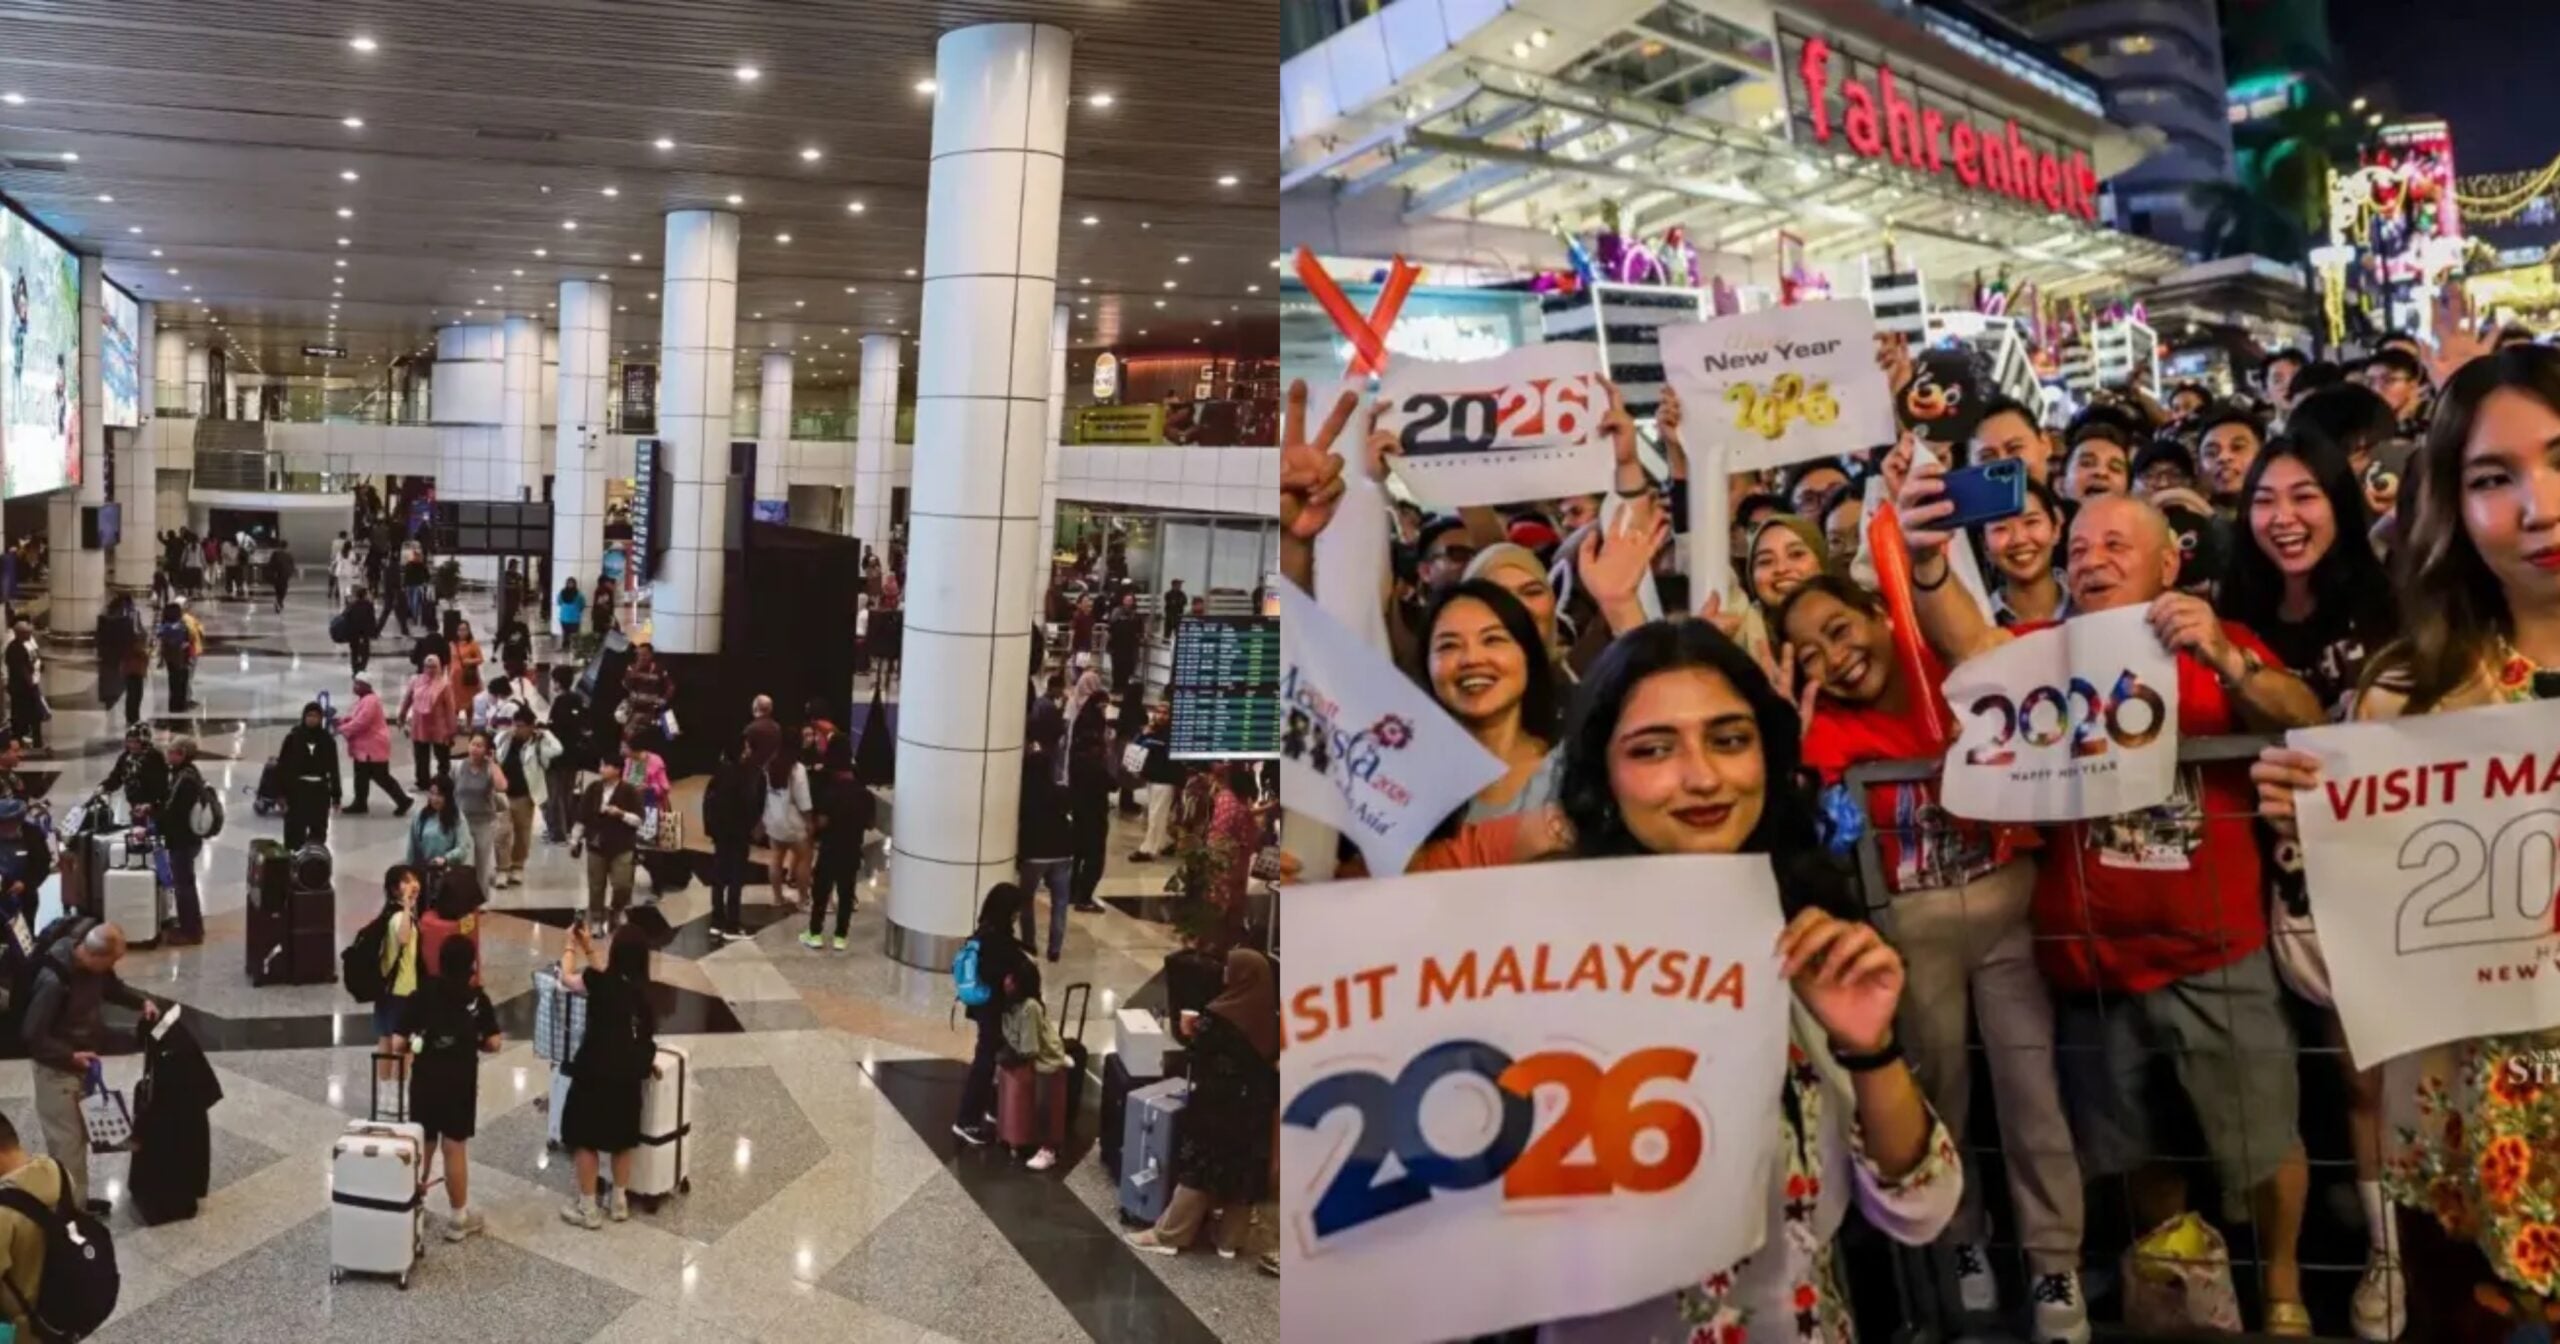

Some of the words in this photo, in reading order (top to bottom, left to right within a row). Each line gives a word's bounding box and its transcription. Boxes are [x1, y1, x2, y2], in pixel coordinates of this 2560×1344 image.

[1800, 36, 2098, 223] fahrenheit
[1703, 351, 1769, 373] New
[1773, 338, 1842, 362] Year
[1401, 376, 1590, 456] 2026
[1723, 372, 1840, 440] 2026
[1965, 668, 2166, 766] 2026
[2082, 760, 2119, 776] YEAR
[2324, 760, 2469, 822] VISIT
[1417, 943, 1746, 1011] MALAYSIA
[2476, 964, 2540, 983] NEW
[1281, 1038, 1704, 1239] 2026
